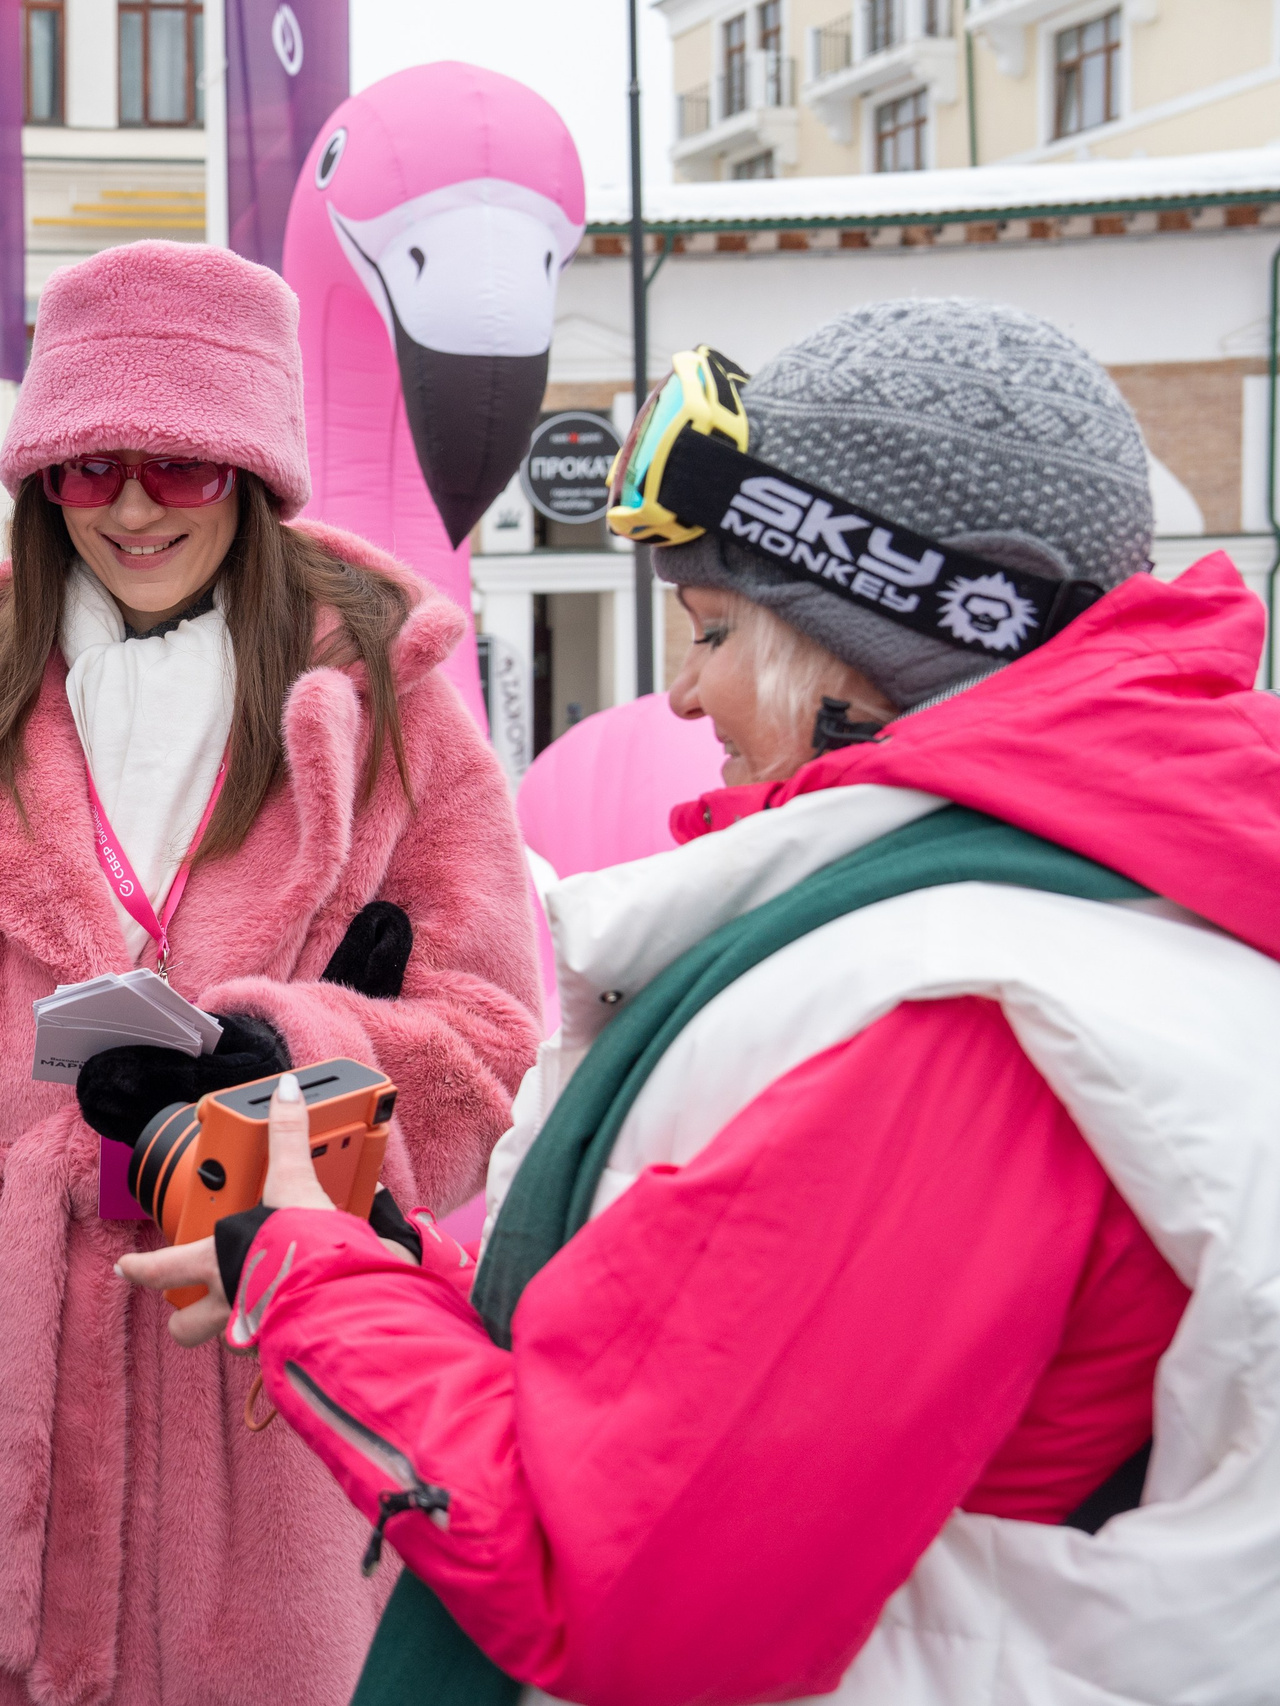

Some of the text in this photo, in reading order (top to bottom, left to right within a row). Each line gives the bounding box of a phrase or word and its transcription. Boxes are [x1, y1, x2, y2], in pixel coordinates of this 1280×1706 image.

[720, 508, 921, 613] MONKEY
[729, 475, 945, 588] SKY
[91, 805, 124, 879] СБЕР Бизнес
